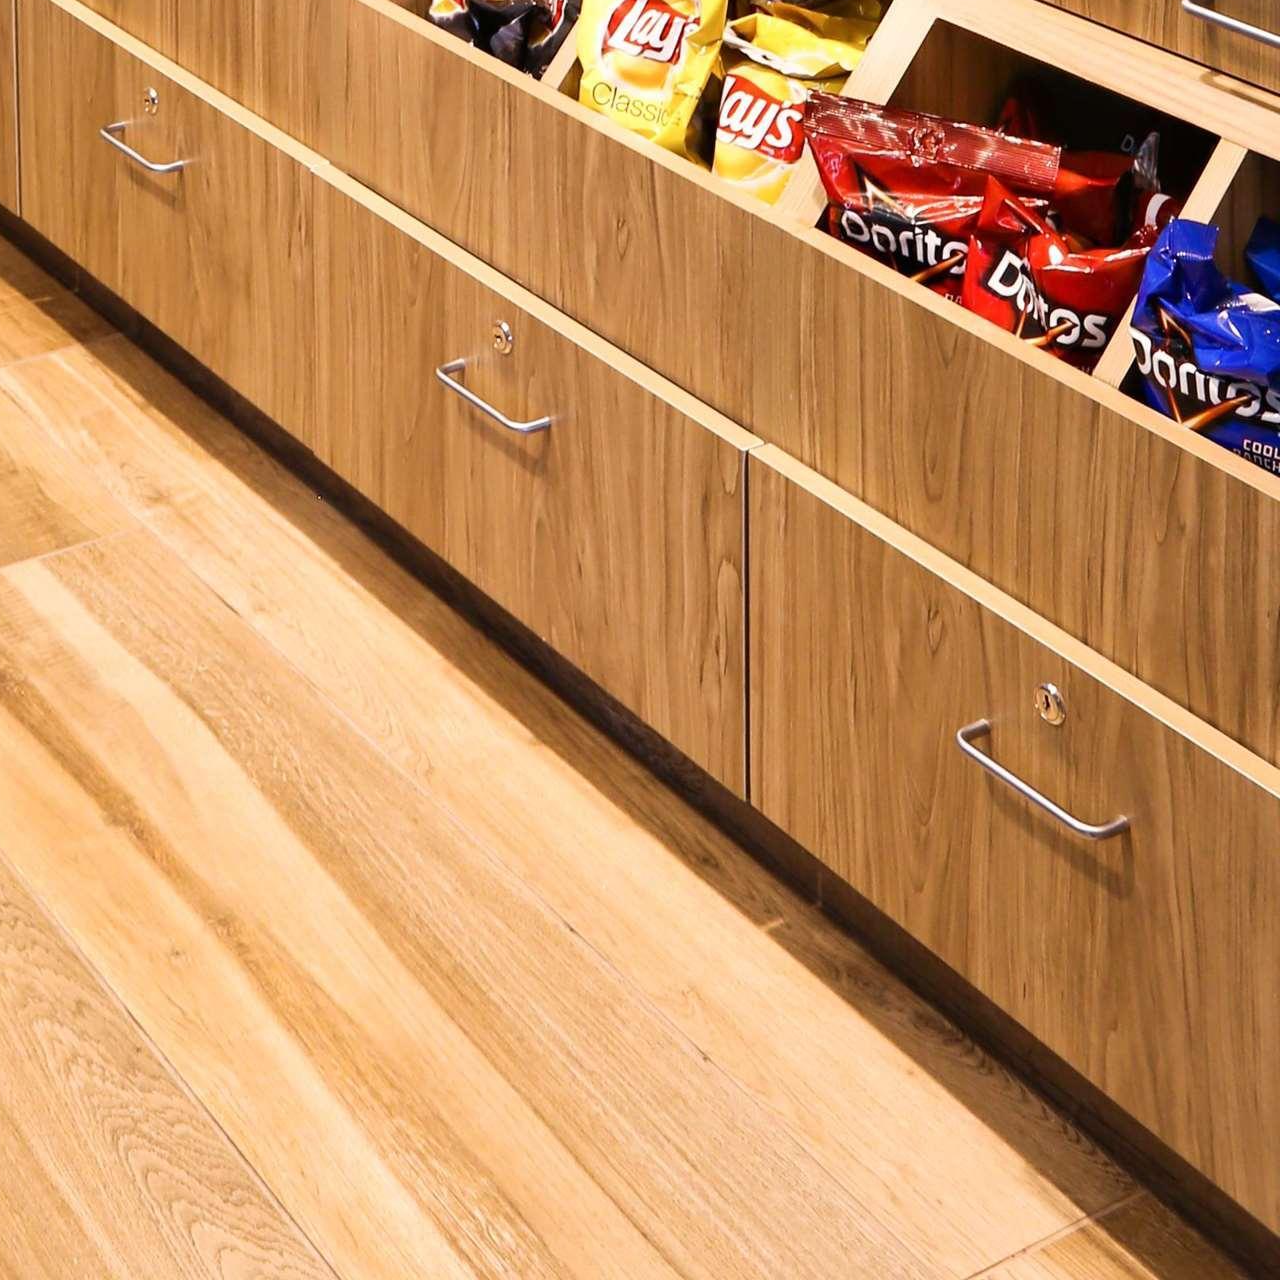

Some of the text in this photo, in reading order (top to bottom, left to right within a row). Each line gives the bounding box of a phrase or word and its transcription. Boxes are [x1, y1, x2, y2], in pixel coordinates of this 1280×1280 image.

[592, 81, 671, 128] Classic
[841, 210, 969, 275] Dorito
[988, 249, 1108, 348] Dotos
[1243, 438, 1280, 459] COOL
